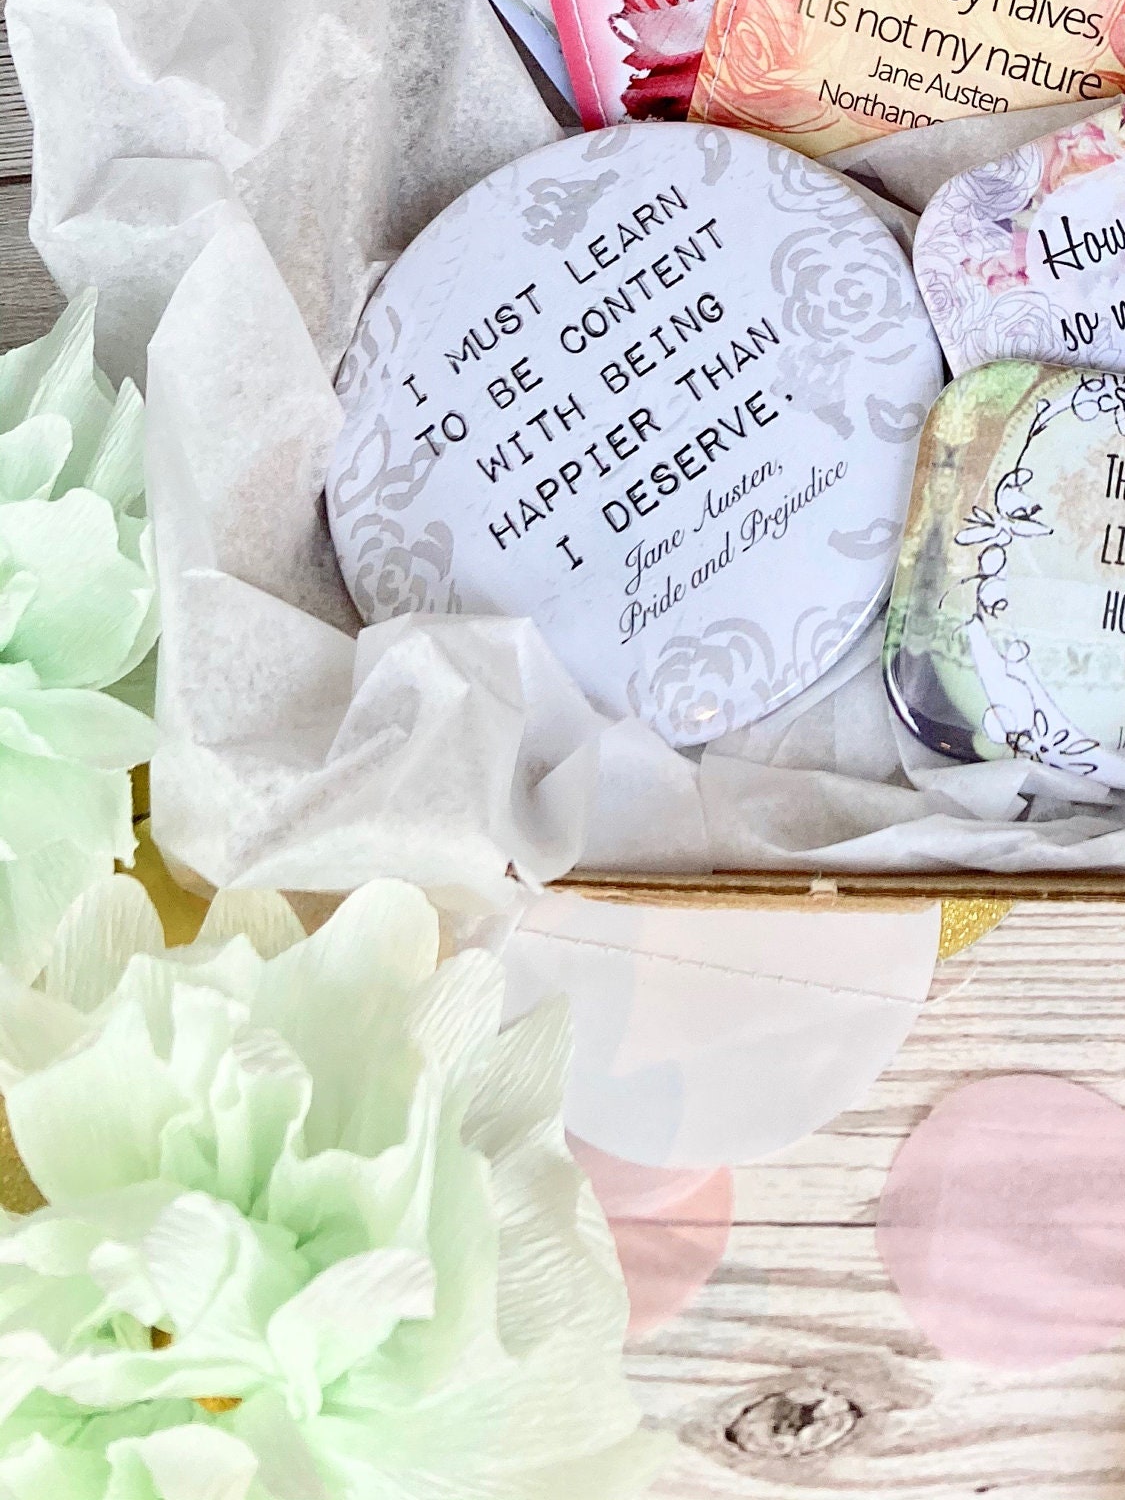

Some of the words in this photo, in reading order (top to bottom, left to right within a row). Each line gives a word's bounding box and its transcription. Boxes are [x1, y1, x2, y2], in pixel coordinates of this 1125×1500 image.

[819, 79, 944, 128] Northang
[855, 3, 918, 49] not
[921, 29, 983, 74] my
[985, 47, 1103, 100] nature
[868, 56, 923, 91] Jane
[926, 74, 1008, 112] Austen
[402, 374, 429, 406] I
[443, 282, 544, 375] MUST
[564, 184, 690, 285] LEARN
[415, 411, 469, 459] TO
[487, 356, 544, 409] BE
[559, 218, 725, 354] CONTENT
[1059, 308, 1100, 352] so
[476, 392, 587, 483] WITH
[599, 292, 725, 394] BEING
[488, 406, 663, 551] HAPPIER
[675, 316, 781, 403] THAN
[555, 535, 585, 571] I
[602, 389, 794, 534] DESERVE.
[617, 583, 686, 645] Pride
[690, 531, 737, 589] and
[738, 460, 850, 554] Prejudice
[622, 528, 686, 596] Jane
[693, 460, 784, 535] Austen,
